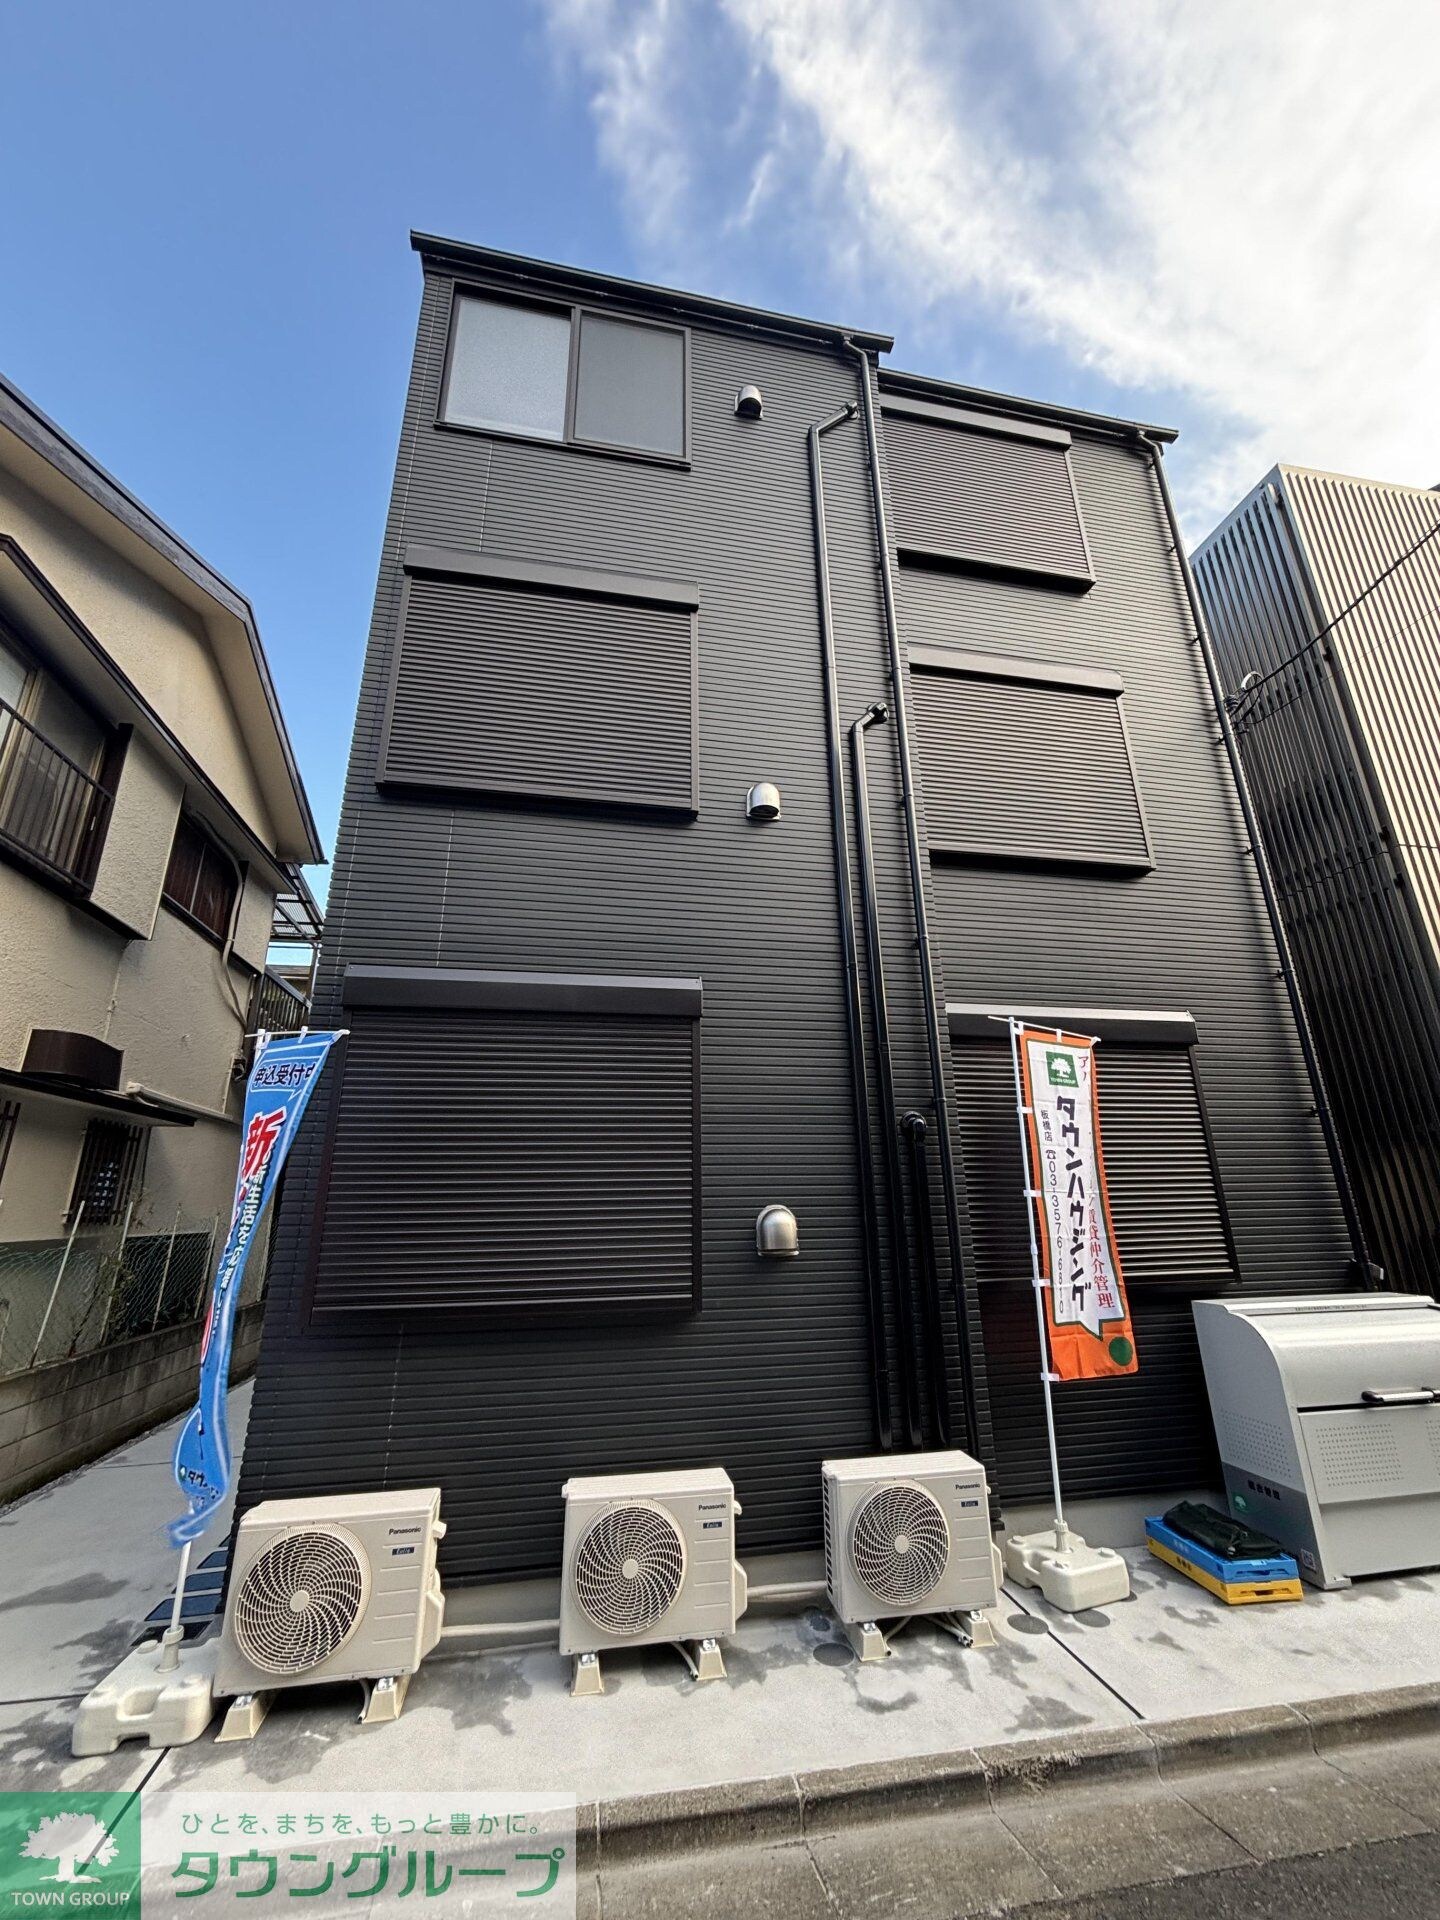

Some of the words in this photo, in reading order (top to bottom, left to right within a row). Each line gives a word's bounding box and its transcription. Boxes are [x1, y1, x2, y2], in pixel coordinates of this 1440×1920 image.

[1056, 1095, 1091, 1312] タウンハウジング
[698, 1502, 727, 1510] Panasonic
[388, 1527, 422, 1535] Panasonic
